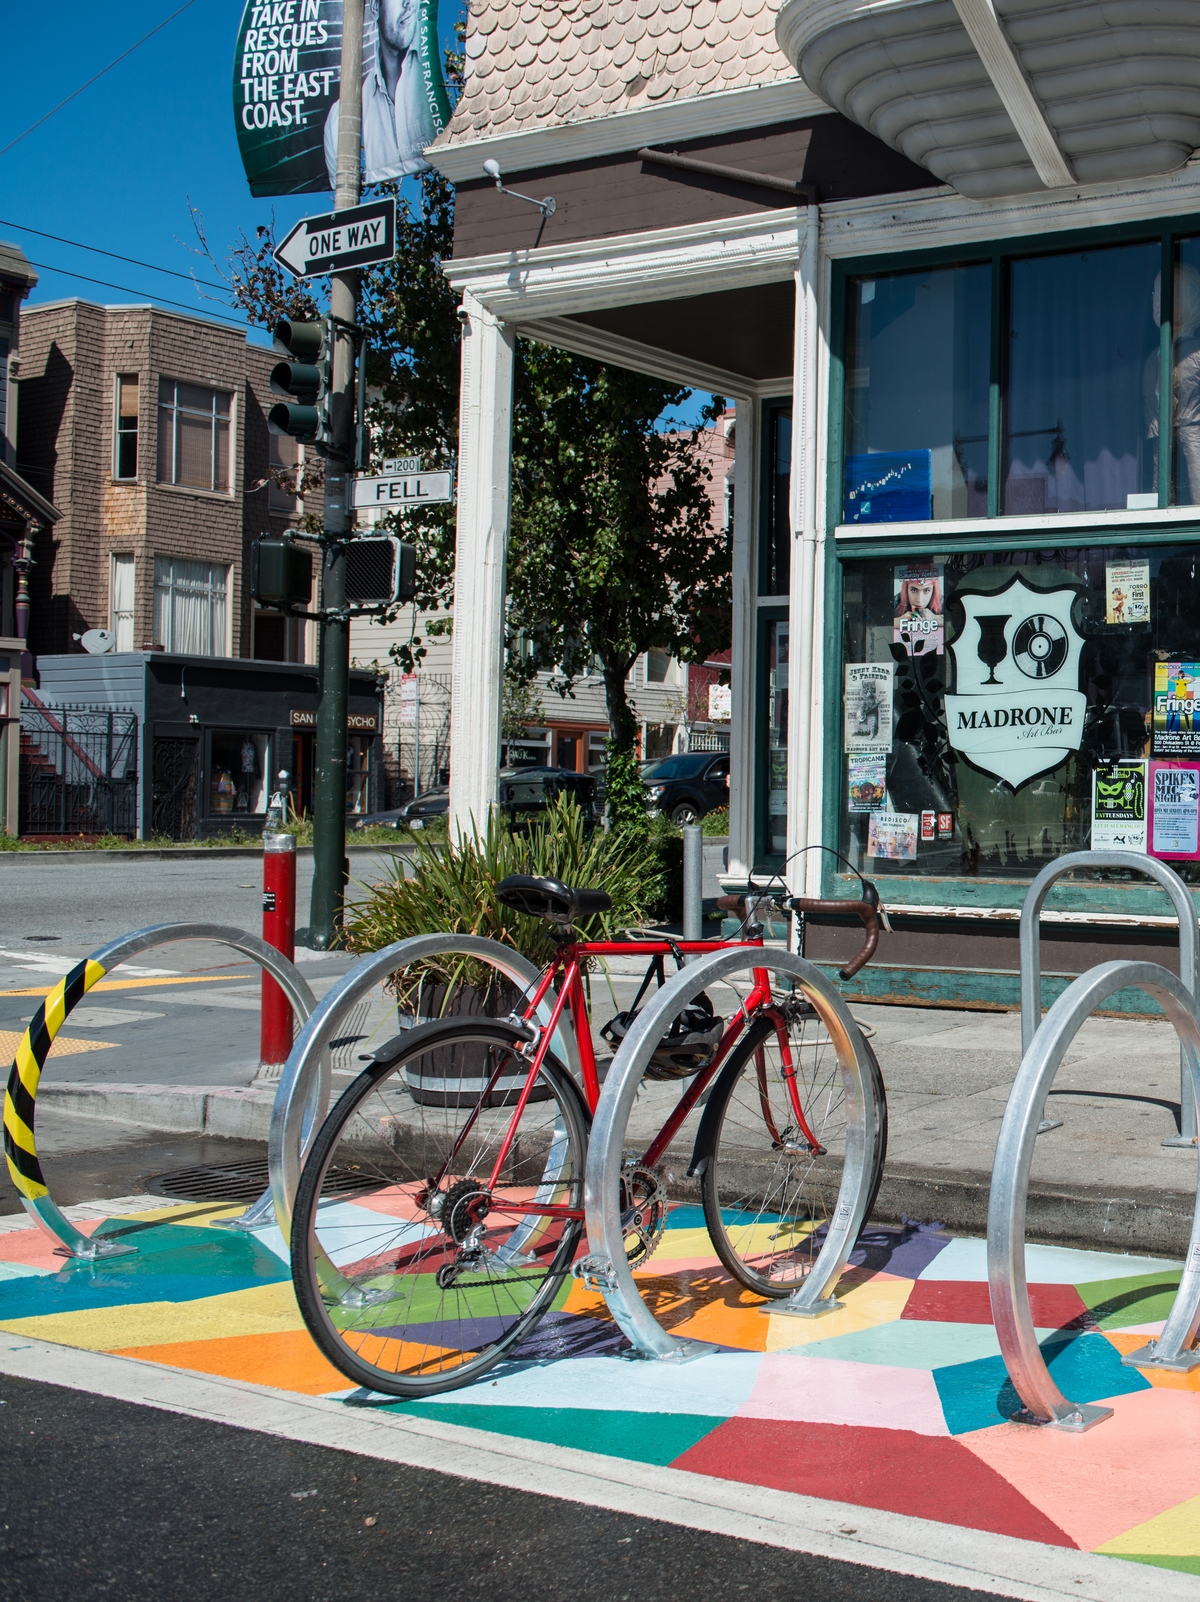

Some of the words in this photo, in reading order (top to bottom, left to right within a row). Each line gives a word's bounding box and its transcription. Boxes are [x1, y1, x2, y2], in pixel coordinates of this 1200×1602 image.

[251, 1, 297, 28] TAKE
[300, 0, 320, 21] IN
[244, 20, 328, 52] RESCUES
[420, 26, 429, 57] SAN
[242, 48, 298, 77] FROM
[241, 76, 278, 103] THE
[284, 71, 334, 99] EAST
[422, 61, 444, 137] FRANCISC
[242, 99, 307, 130] COAST.
[309, 231, 341, 256] ONE
[348, 221, 381, 245] WAY
[394, 459, 415, 472] 1200
[376, 480, 429, 500] FELL
[900, 618, 939, 634] Fringe
[859, 673, 887, 681] FRIENDS
[293, 712, 314, 724] SAN
[957, 706, 1073, 729] MADRONE
[1017, 726, 1040, 741] Art
[1040, 724, 1063, 738] Bar
[850, 755, 885, 764] TROPICANA
[1155, 772, 1195, 785] SPIKE'S
[1155, 794, 1181, 803] NIGHT
[1156, 786, 1179, 795] MIC
[940, 815, 951, 829] SF
